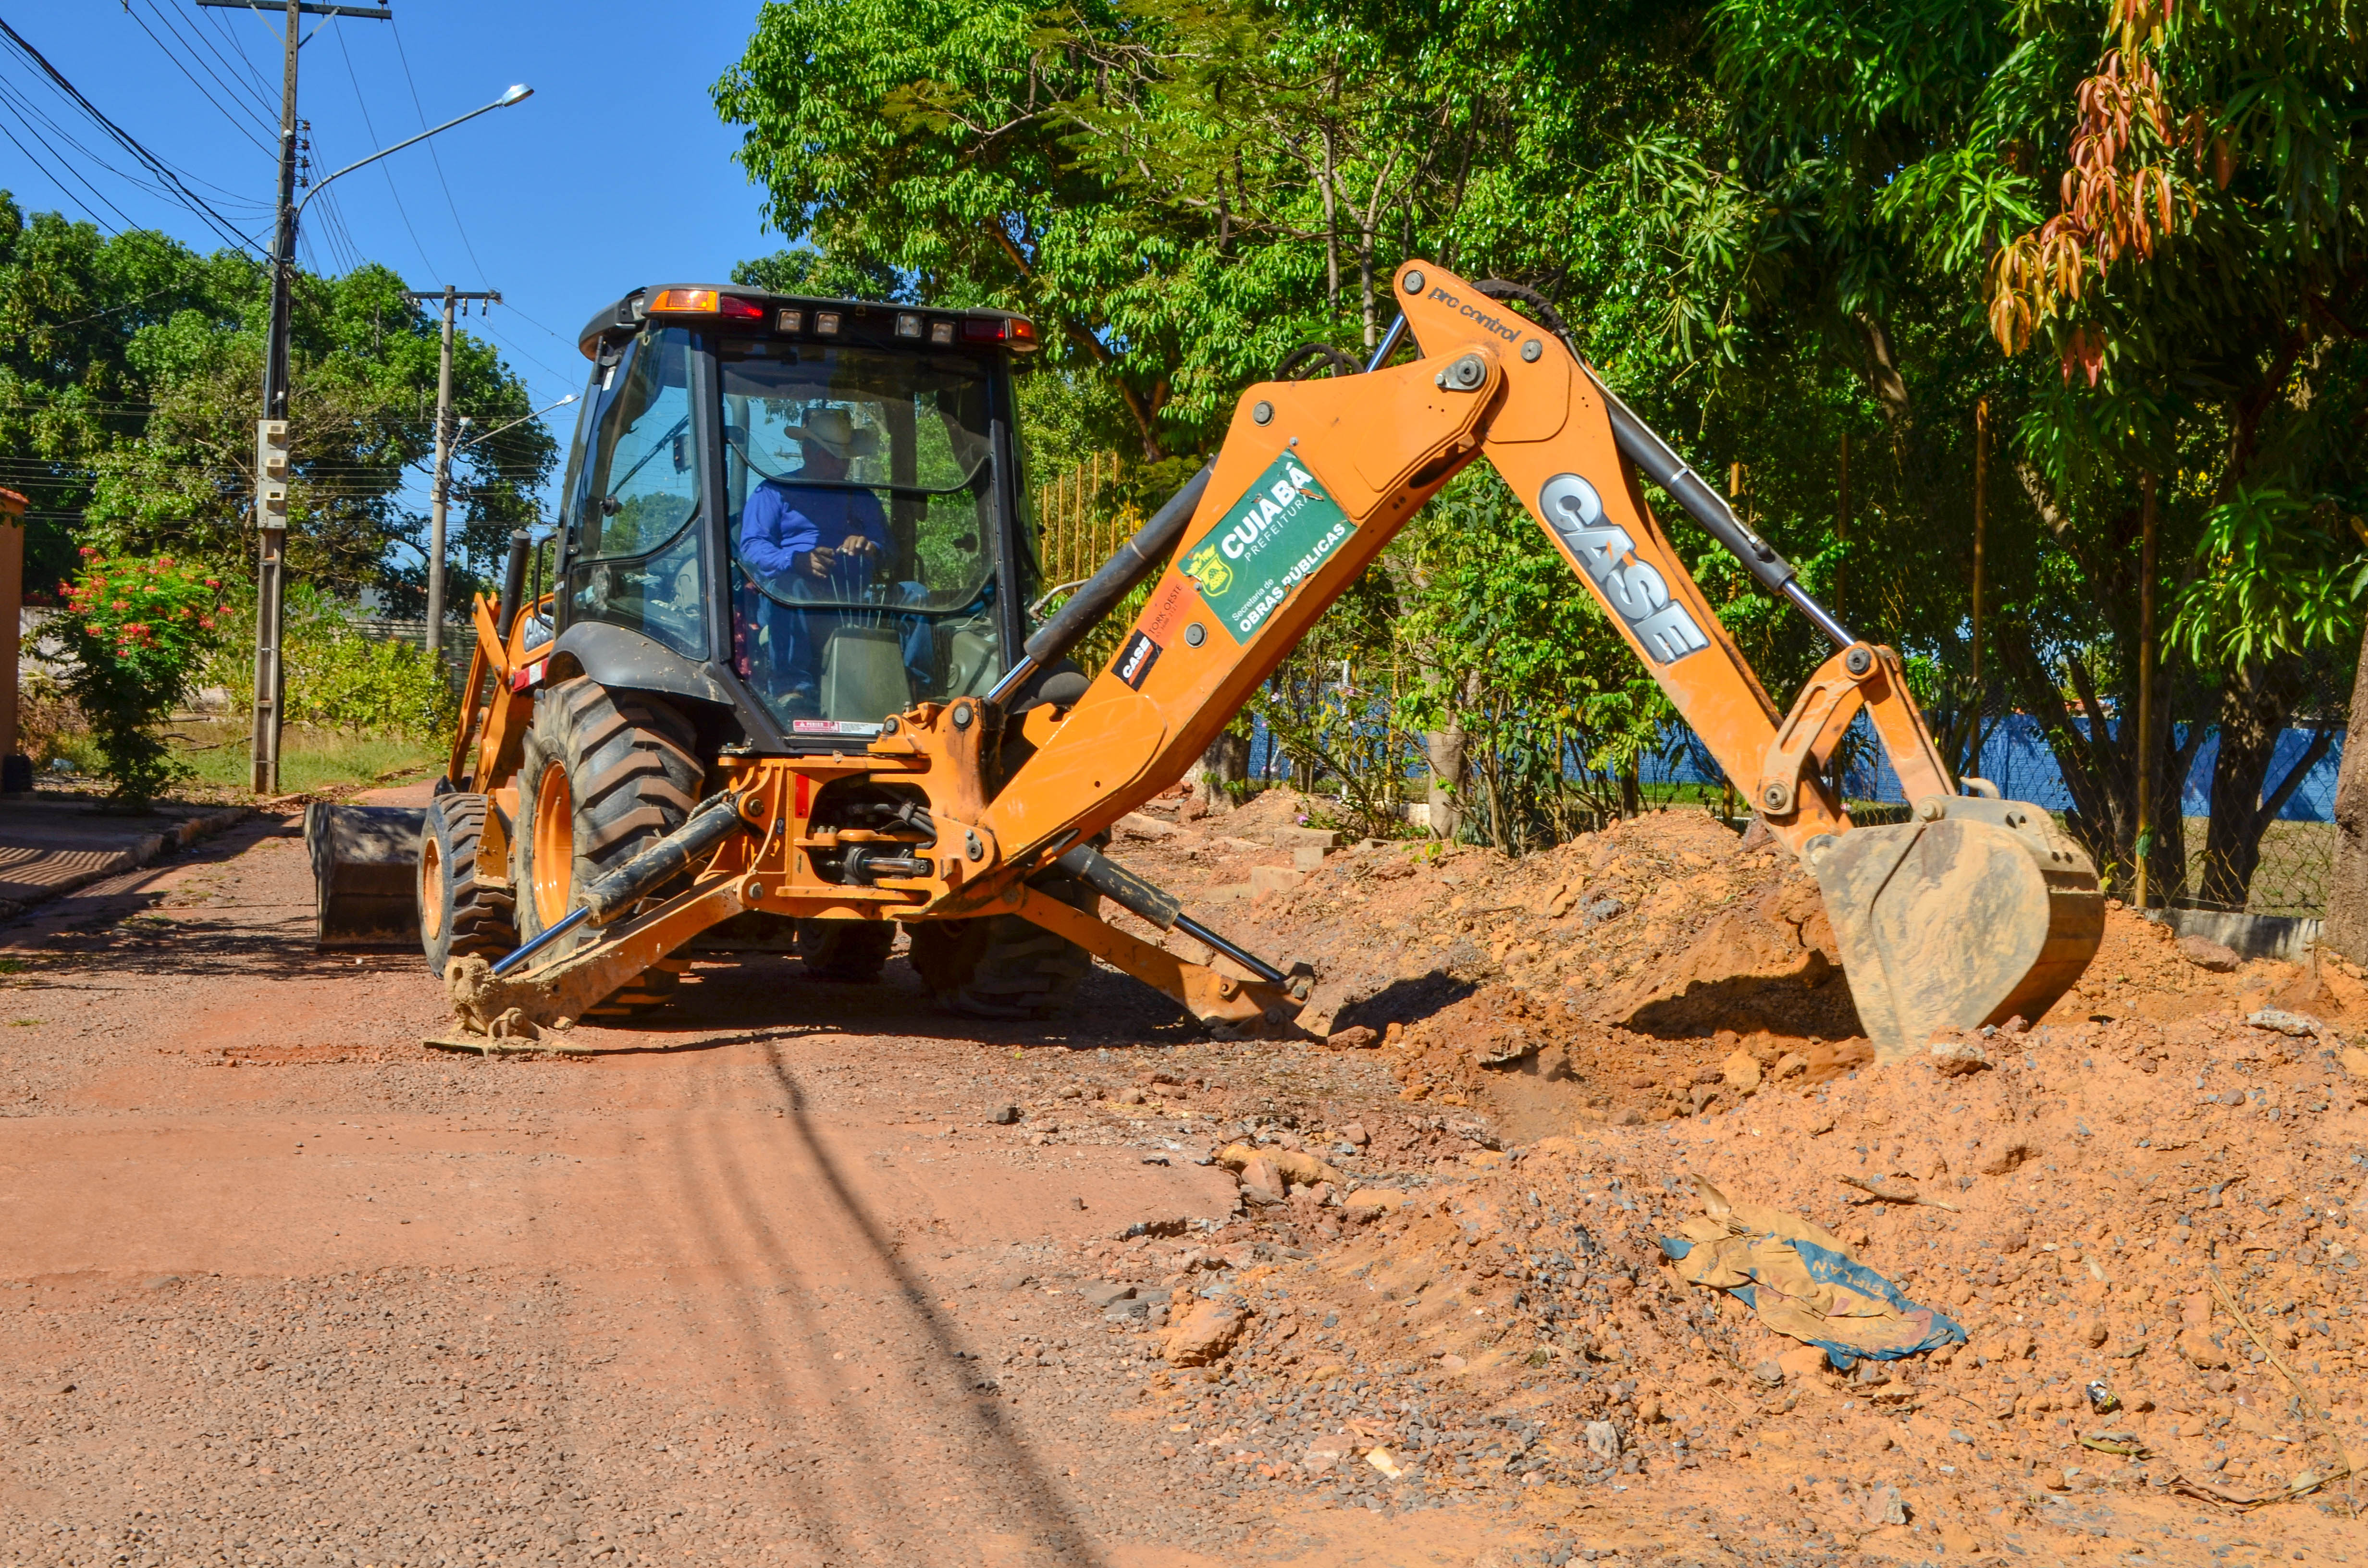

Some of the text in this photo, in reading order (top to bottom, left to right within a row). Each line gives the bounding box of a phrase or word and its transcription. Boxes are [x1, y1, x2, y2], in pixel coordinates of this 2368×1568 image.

[1427, 286, 1522, 343] pro control
[1221, 462, 1313, 559] CUIABÁ
[1240, 523, 1345, 632] OBRAS PÚBLICAS
[1540, 476, 1709, 663] CASE
[1149, 584, 1183, 634] TORK OESTE
[1232, 579, 1274, 621] Secretaria de
[1122, 636, 1151, 678] CASE
[1695, 1257, 1719, 1284] CIPLA
[1812, 1260, 1884, 1296] CIPLAN
